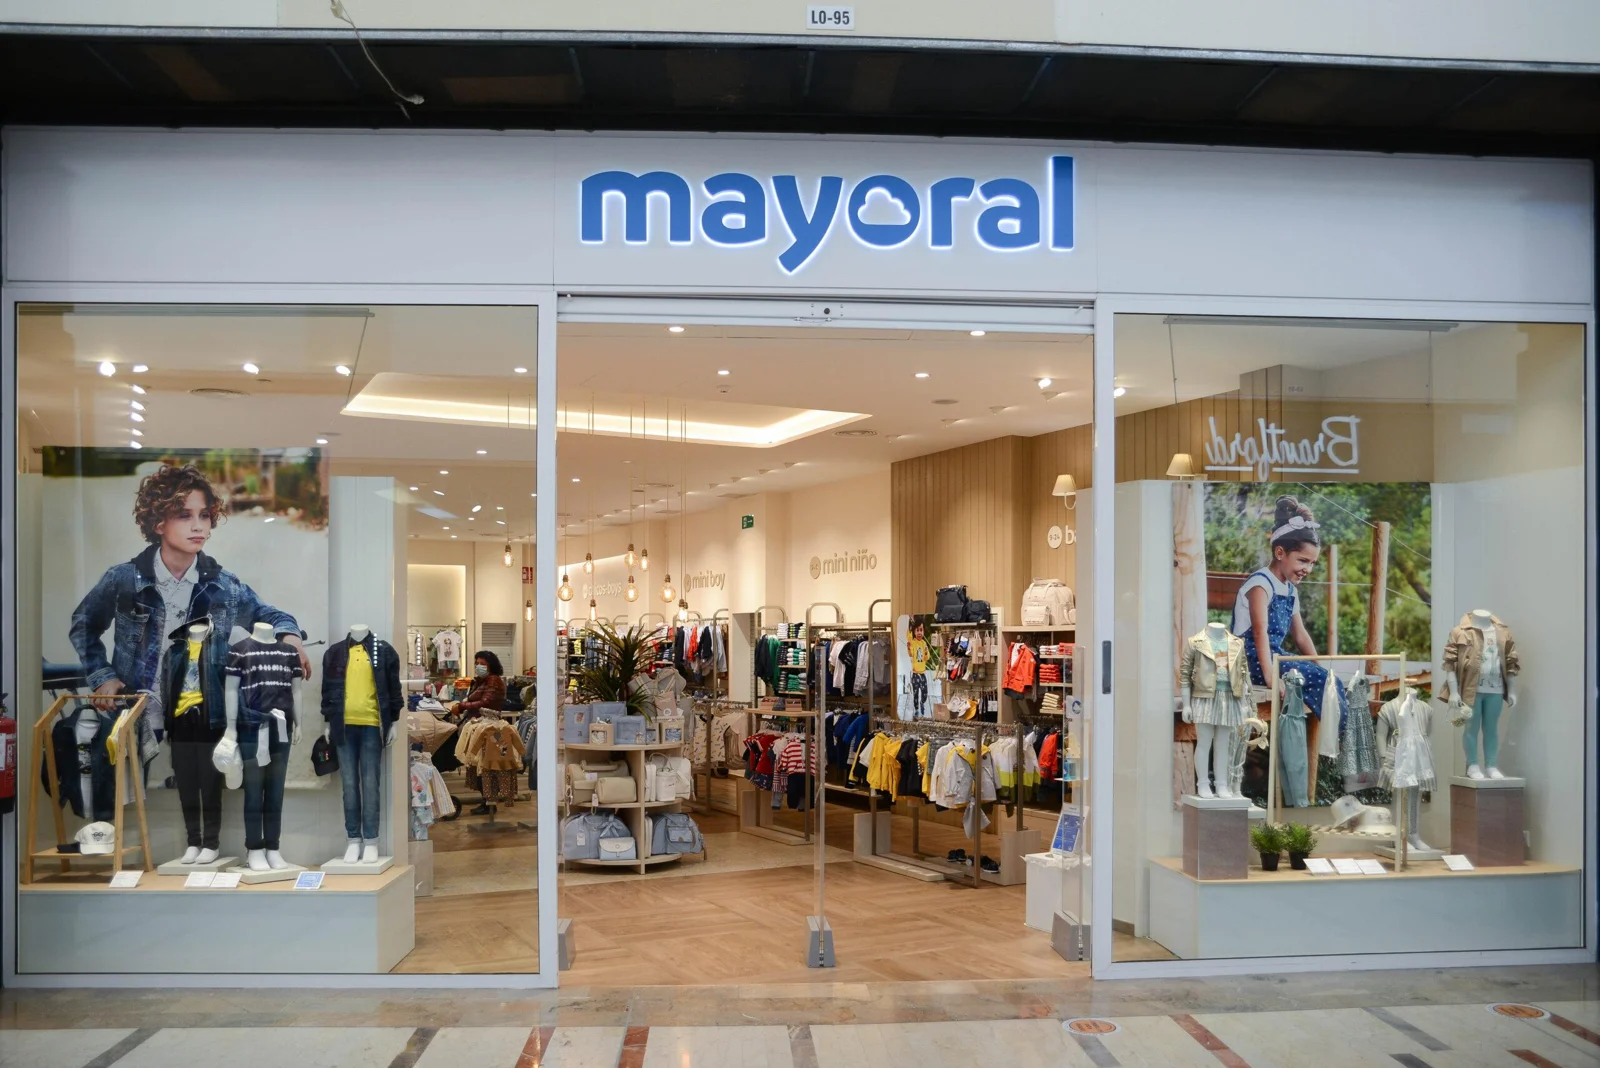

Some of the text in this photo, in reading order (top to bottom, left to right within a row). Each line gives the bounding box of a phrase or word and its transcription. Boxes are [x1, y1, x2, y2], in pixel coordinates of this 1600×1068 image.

[581, 155, 1074, 274] mayoral
[823, 548, 878, 575] mini niño
